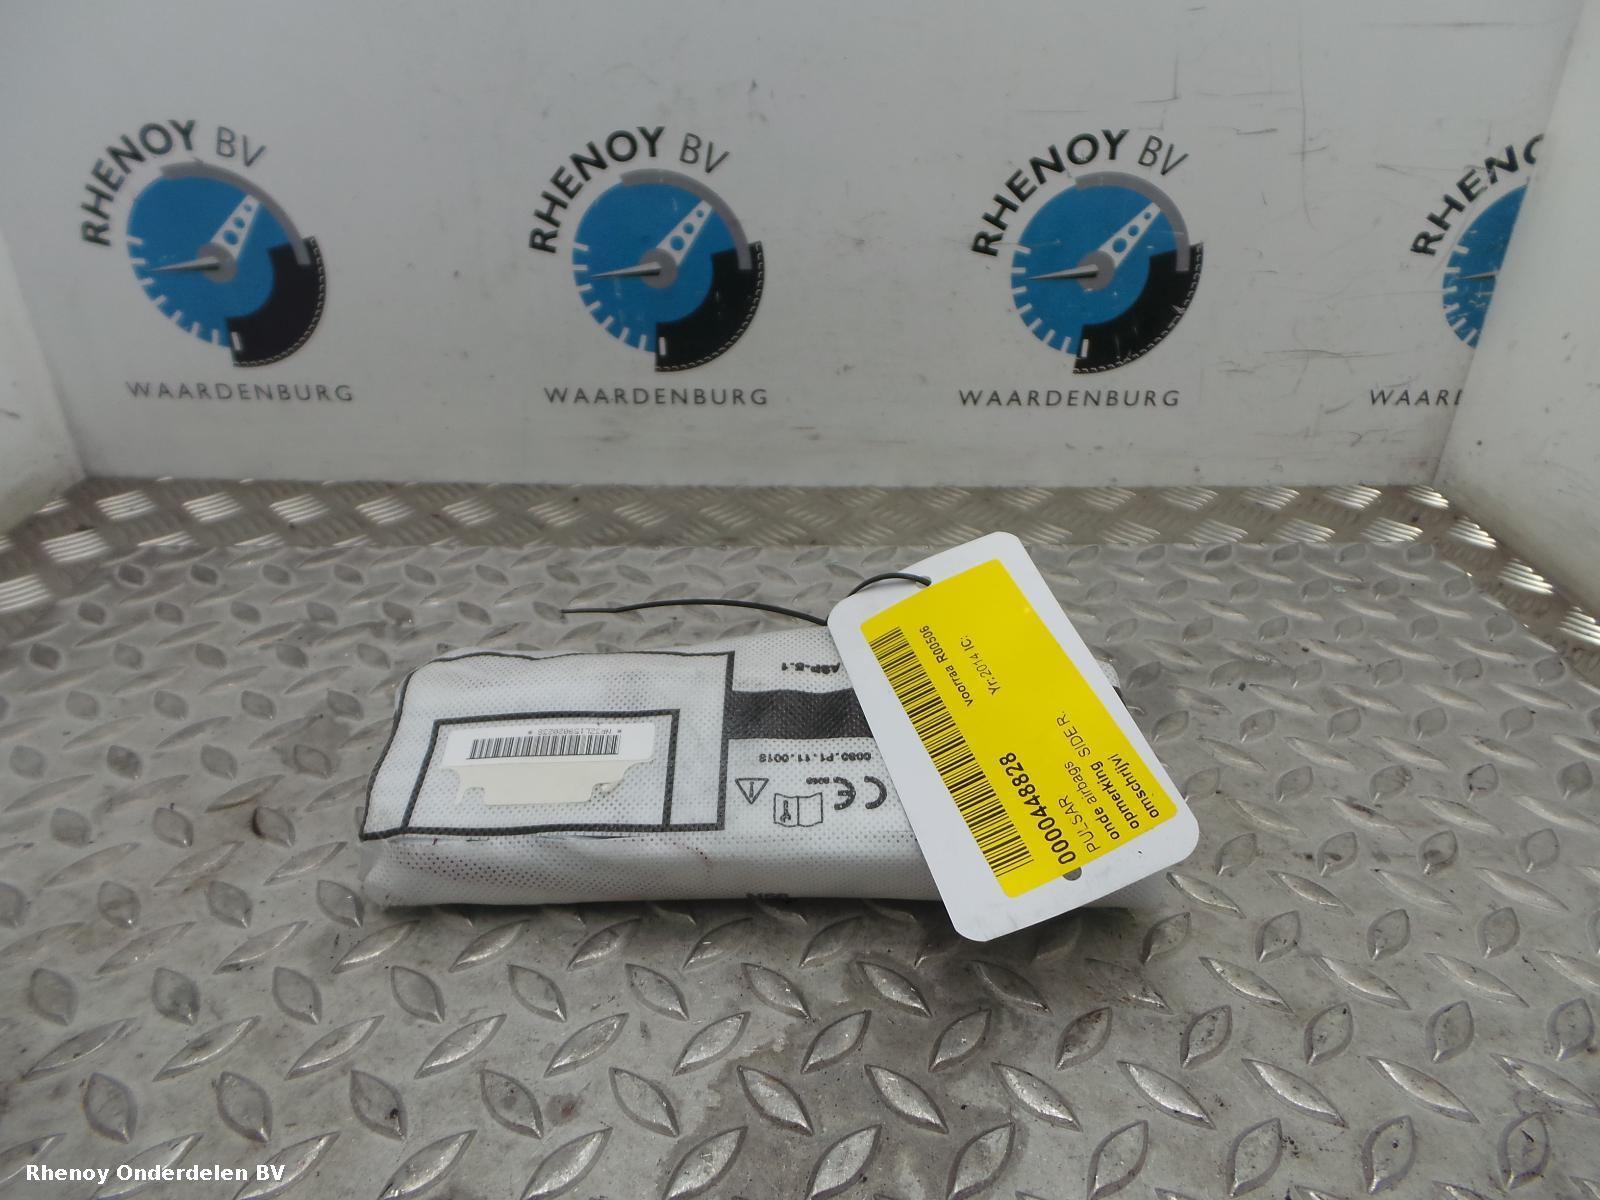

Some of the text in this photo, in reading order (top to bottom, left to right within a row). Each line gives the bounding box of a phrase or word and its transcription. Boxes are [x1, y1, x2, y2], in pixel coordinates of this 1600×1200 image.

[81, 119, 267, 247] RHENOY BV
[529, 126, 730, 254] RHENOY BV
[971, 129, 1189, 257] RHENOY BV
[126, 381, 354, 402] WAARDENBURG
[544, 387, 768, 405] WAARDENBURG
[959, 390, 1180, 407] WAARDENBURG
[919, 625, 974, 706] voorraa R00506
[1063, 727, 1091, 758] SIDE
[998, 752, 1077, 865] 0000448828
[1058, 794, 1101, 853] PULSAR
[1064, 761, 1121, 841] onde airbags
[1090, 761, 1140, 830] opmerking
